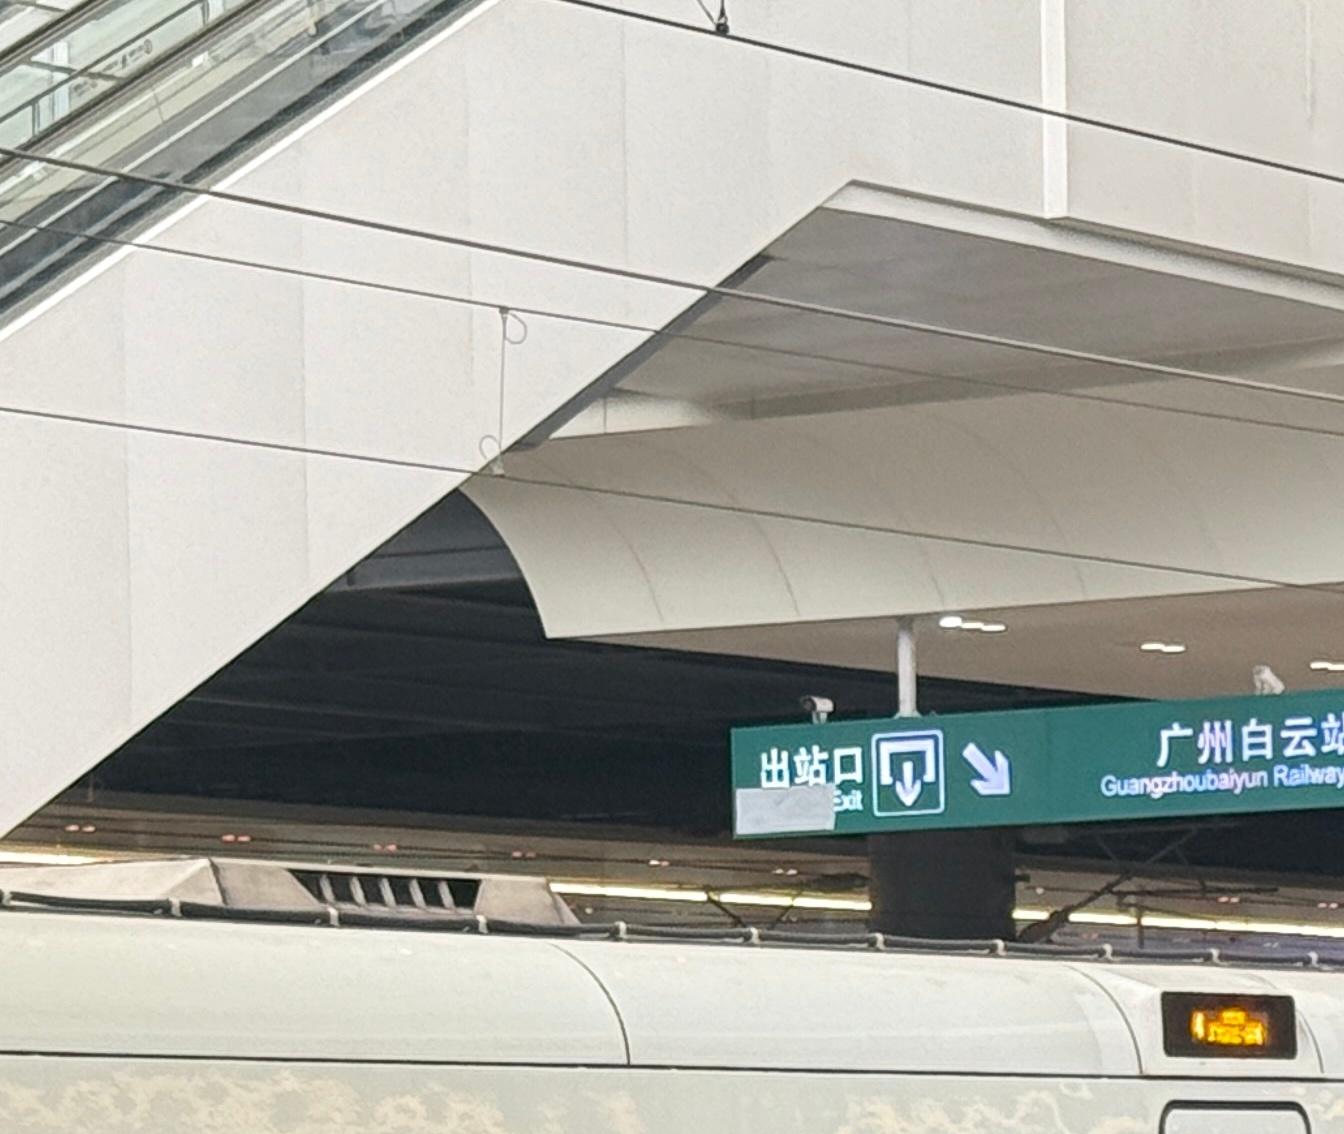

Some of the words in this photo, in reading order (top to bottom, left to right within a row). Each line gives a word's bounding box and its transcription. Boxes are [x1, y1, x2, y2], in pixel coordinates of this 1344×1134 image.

[761, 744, 864, 789] 出站口
[1101, 769, 1268, 799] Guangzhoubaiyun
